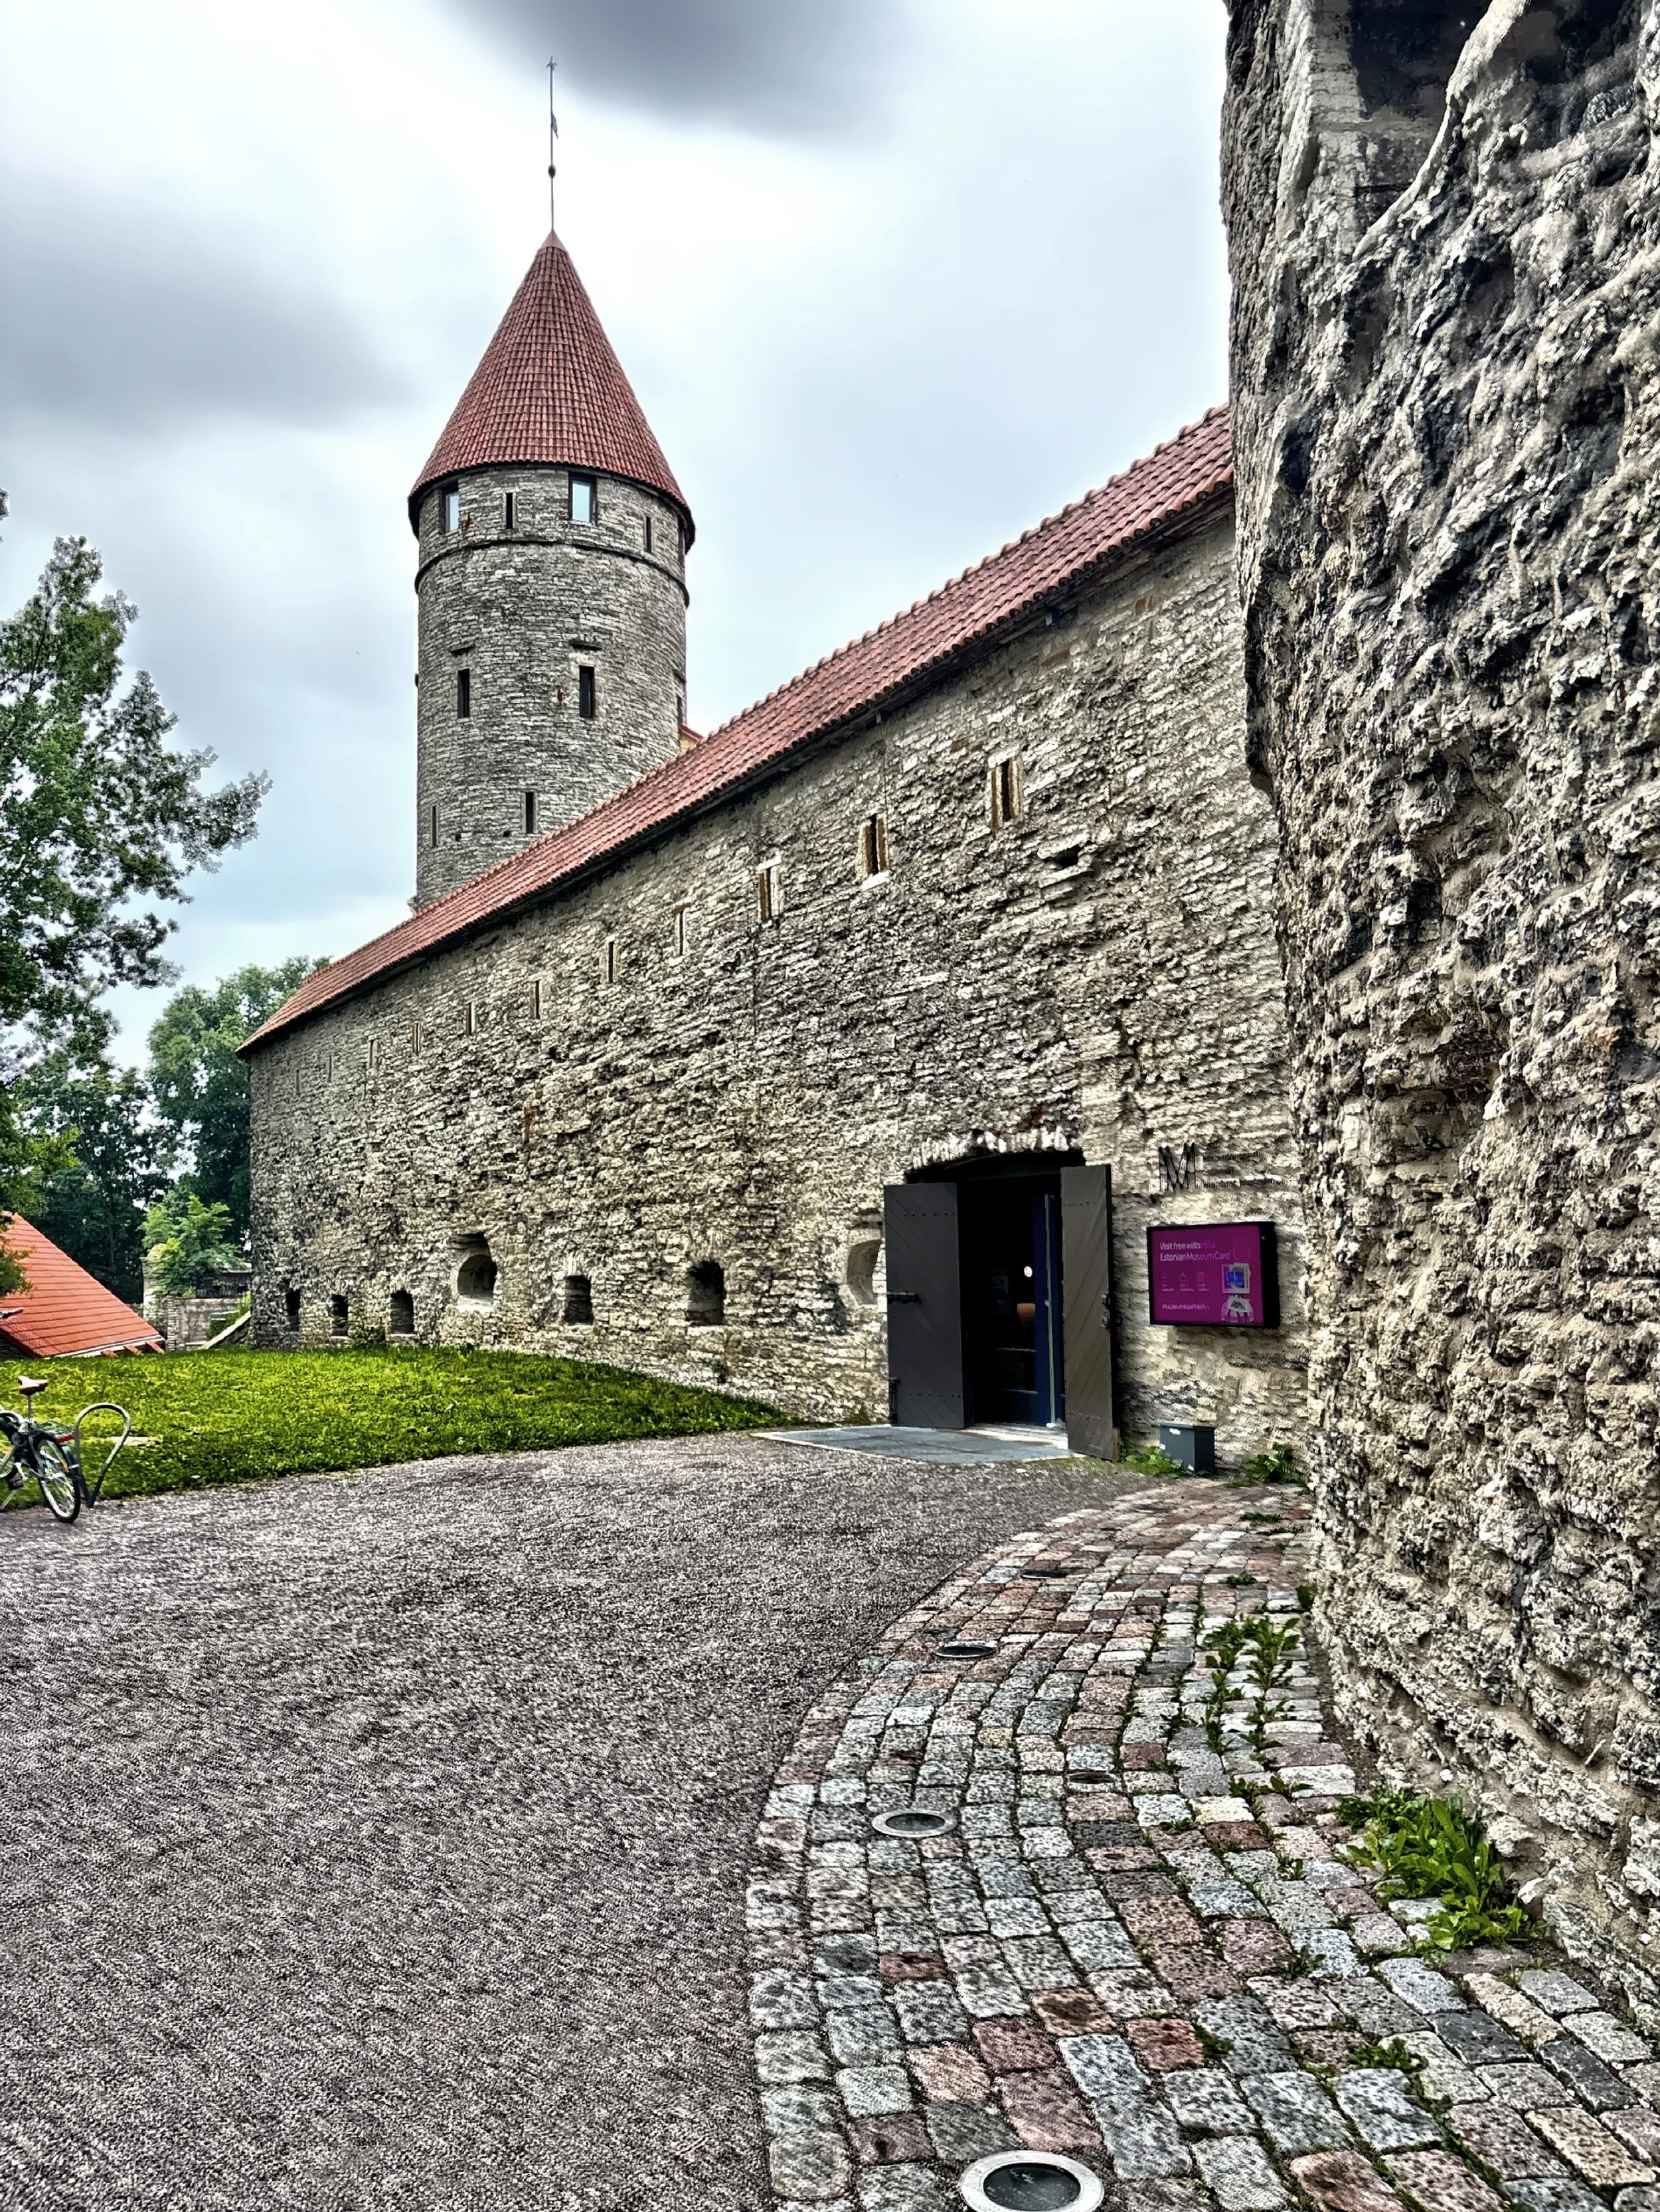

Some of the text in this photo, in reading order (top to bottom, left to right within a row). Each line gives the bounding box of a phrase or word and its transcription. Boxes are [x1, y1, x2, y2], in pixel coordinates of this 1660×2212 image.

[1159, 1142, 1195, 1190] M
[1159, 1241, 1173, 1250] Visit
[1160, 1253, 1187, 1261] Estonian
[1187, 1252, 1214, 1261] Museum
